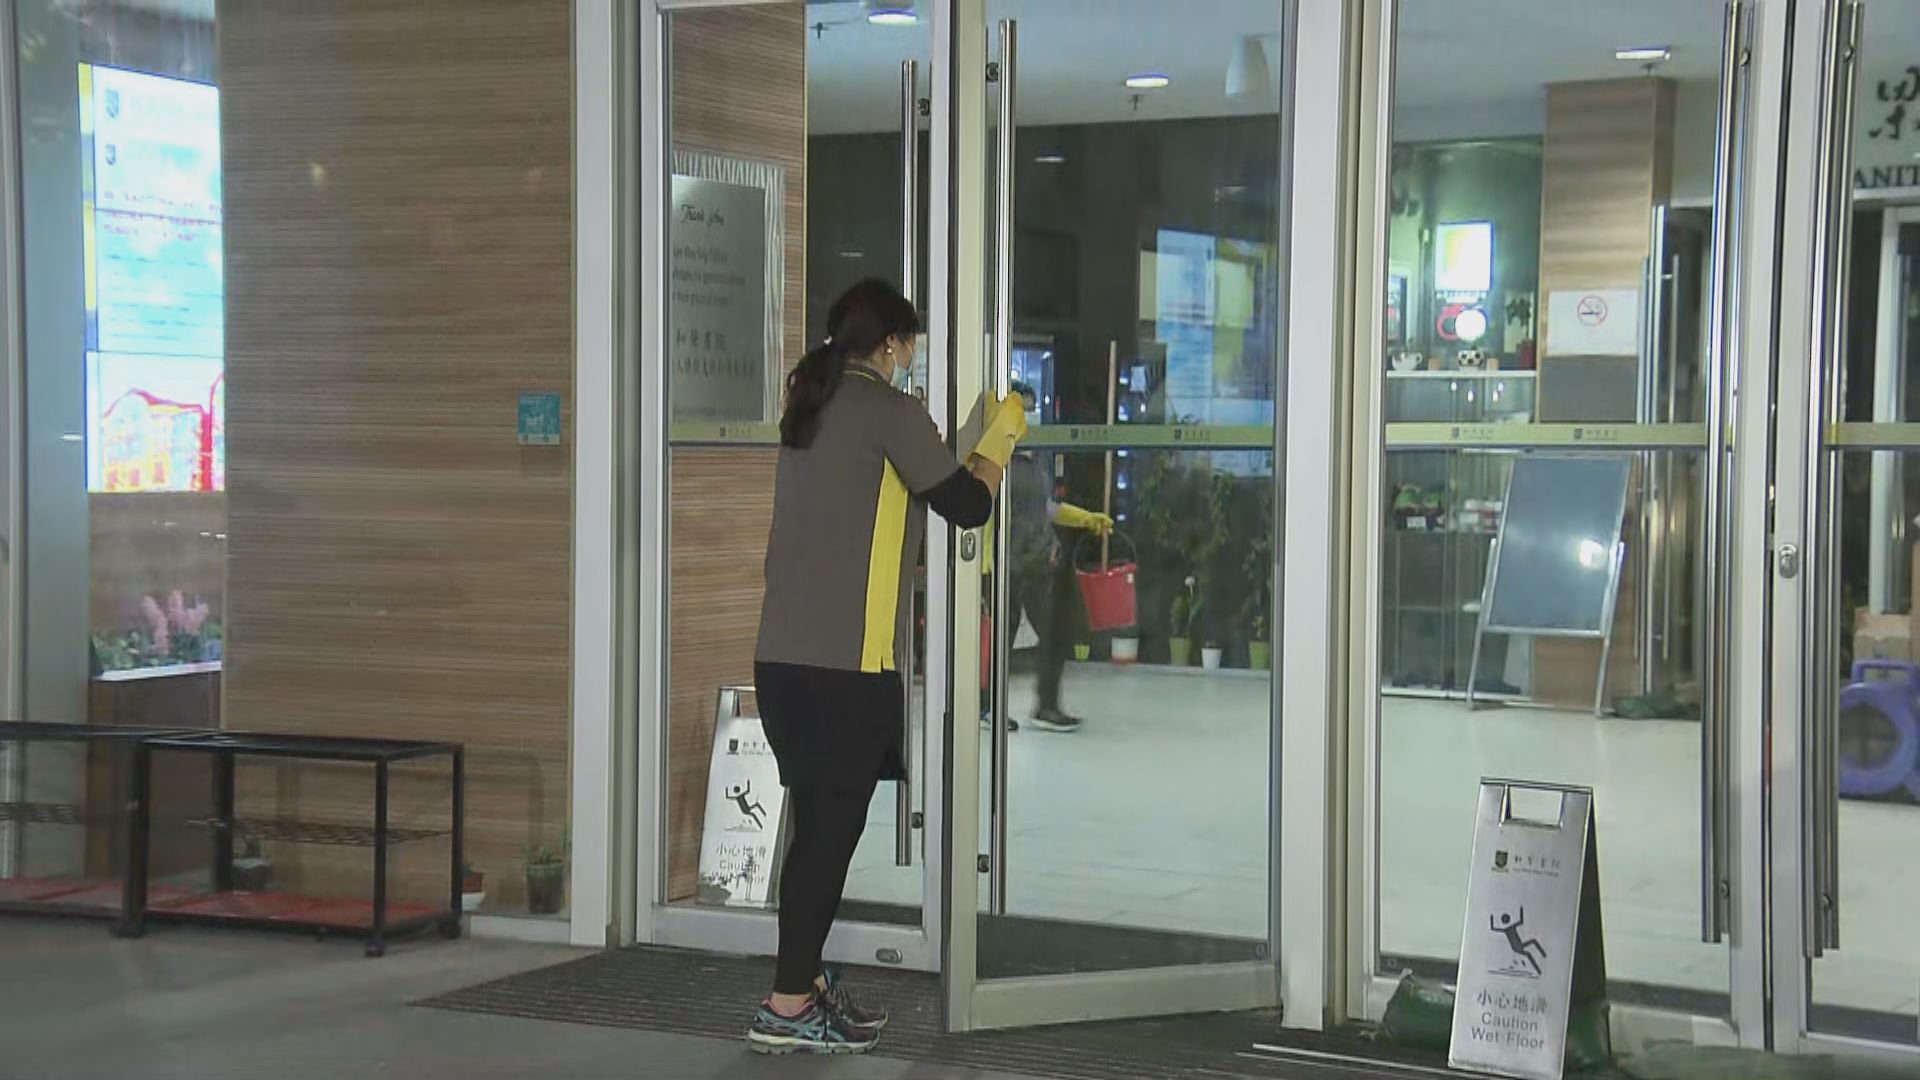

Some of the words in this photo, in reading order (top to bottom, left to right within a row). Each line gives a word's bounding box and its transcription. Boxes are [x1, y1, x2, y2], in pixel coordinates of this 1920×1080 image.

[1481, 1011, 1538, 1032] Caution
[1471, 1026, 1499, 1043] Wet
[1506, 1031, 1545, 1050] Floor
